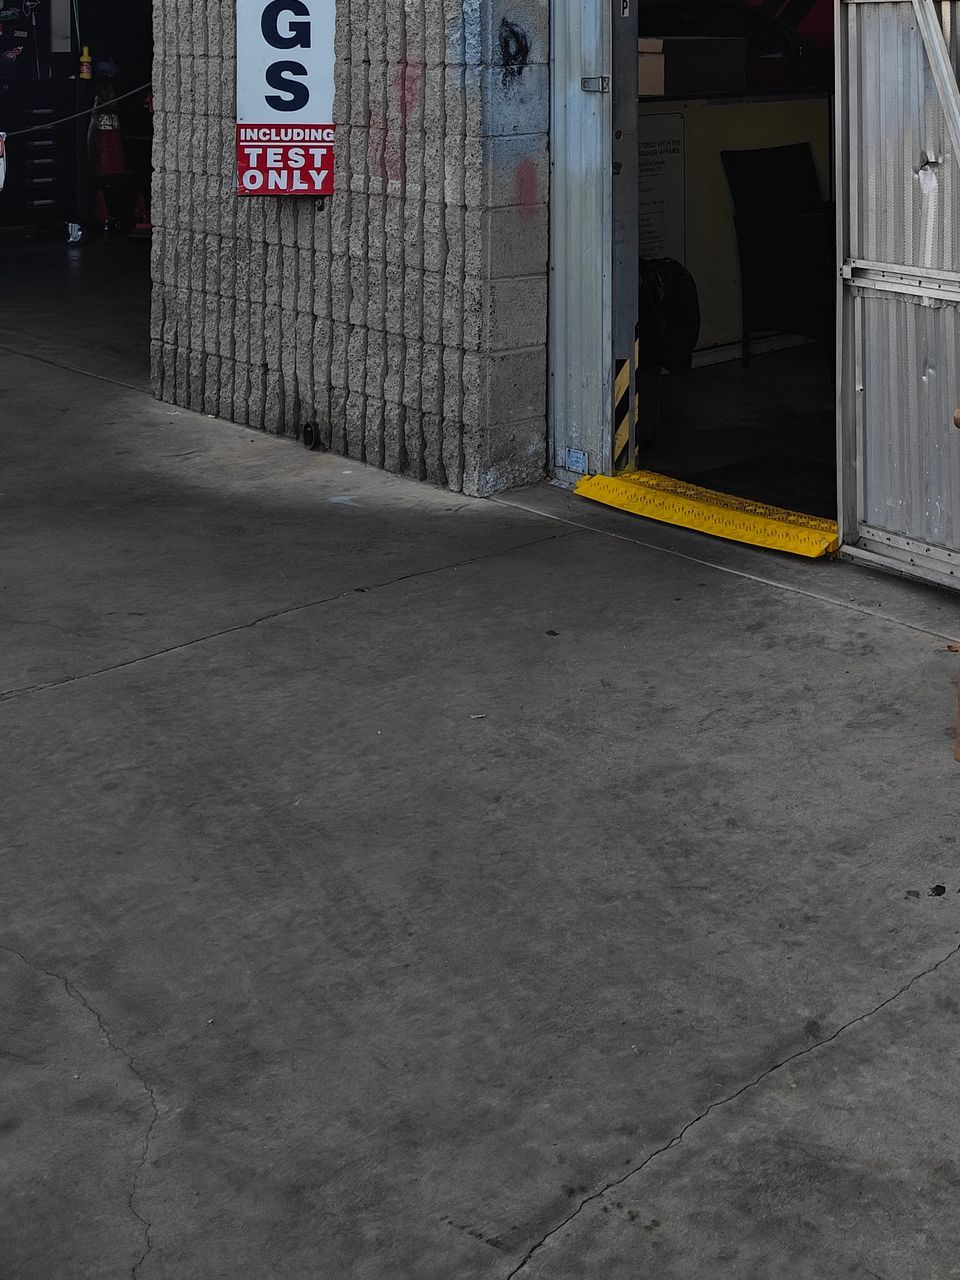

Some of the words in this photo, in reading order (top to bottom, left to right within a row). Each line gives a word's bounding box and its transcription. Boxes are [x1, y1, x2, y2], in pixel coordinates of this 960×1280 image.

[240, 128, 335, 141] INCLUDING
[244, 147, 327, 168] TEST
[242, 169, 329, 190] ONLY
